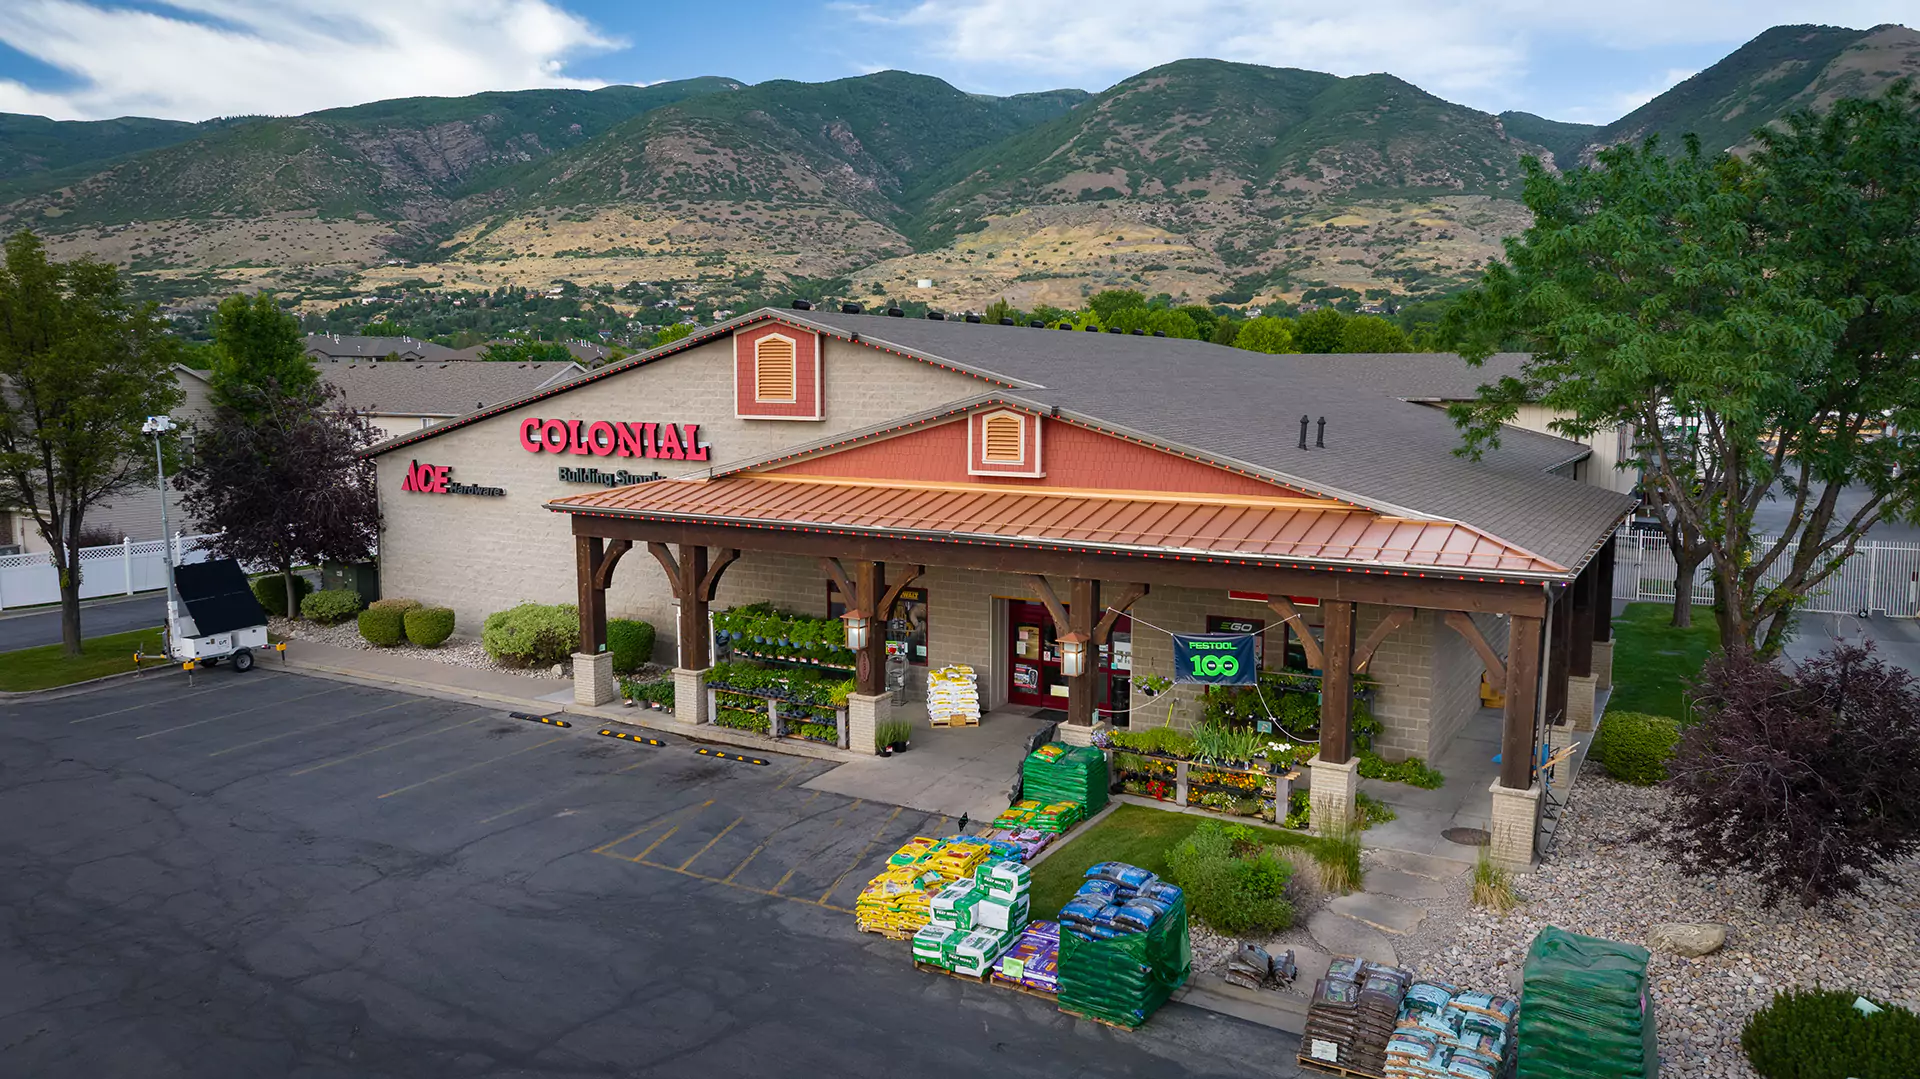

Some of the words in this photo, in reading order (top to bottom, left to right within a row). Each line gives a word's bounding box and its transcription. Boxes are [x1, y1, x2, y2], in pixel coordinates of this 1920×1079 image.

[520, 417, 708, 461] COLONIAL
[401, 459, 450, 494] ACE
[450, 482, 503, 496] Hardware
[558, 467, 614, 487] Building
[615, 469, 667, 485] Suppl
[1220, 621, 1253, 632] EGO
[1188, 641, 1239, 650] FESTOOL
[1190, 654, 1240, 677] 100
